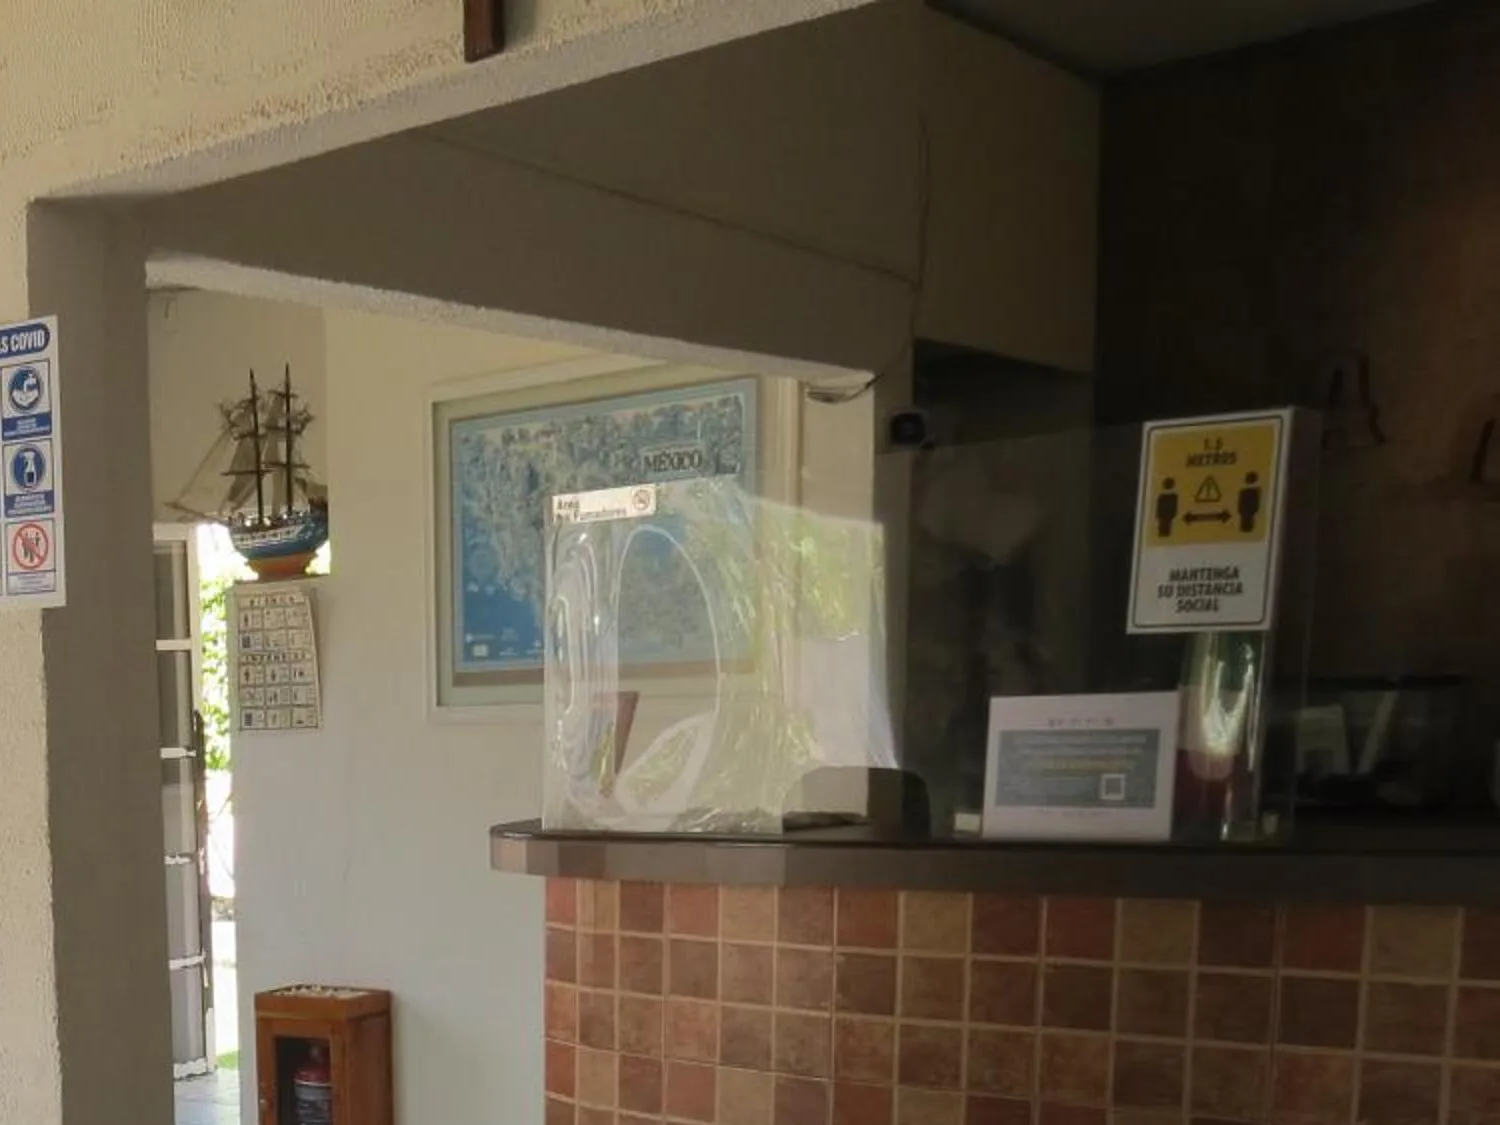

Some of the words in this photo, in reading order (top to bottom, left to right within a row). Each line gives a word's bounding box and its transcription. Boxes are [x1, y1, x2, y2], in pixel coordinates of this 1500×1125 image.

[10, 327, 46, 349] COVID
[1169, 567, 1240, 583] MANTENGA
[1175, 581, 1244, 599] DISTANCIA
[1175, 600, 1219, 613] SOCIAL
